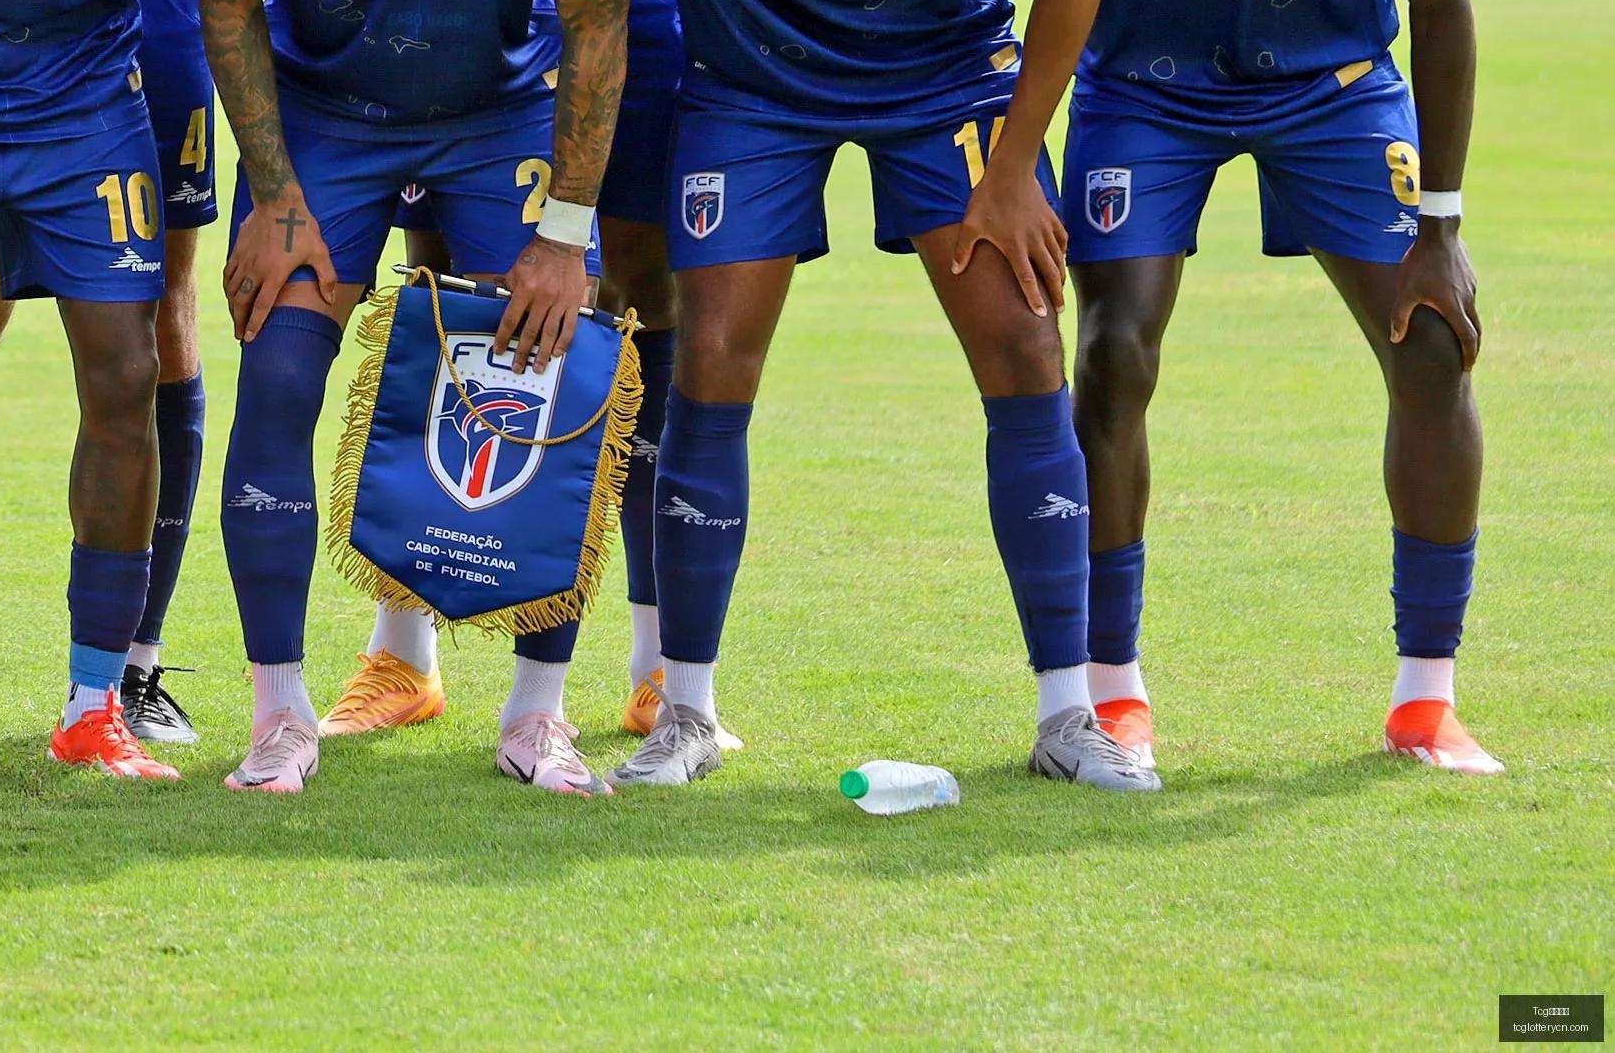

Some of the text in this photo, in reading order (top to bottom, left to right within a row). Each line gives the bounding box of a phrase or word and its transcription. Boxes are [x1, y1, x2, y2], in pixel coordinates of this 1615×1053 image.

[180, 106, 207, 174] 4
[685, 176, 720, 188] FCF
[1089, 171, 1127, 183] FCF
[1385, 141, 1420, 206] 8
[515, 158, 552, 223] 2
[96, 171, 160, 244] 10
[255, 500, 312, 513] tempo
[1061, 505, 1090, 519] tem
[684, 514, 741, 530] tempo
[425, 525, 503, 551] FEDERAÇÃO
[406, 540, 516, 572] CABO-VERDIANA
[416, 560, 500, 587] DE FUTEBOL
